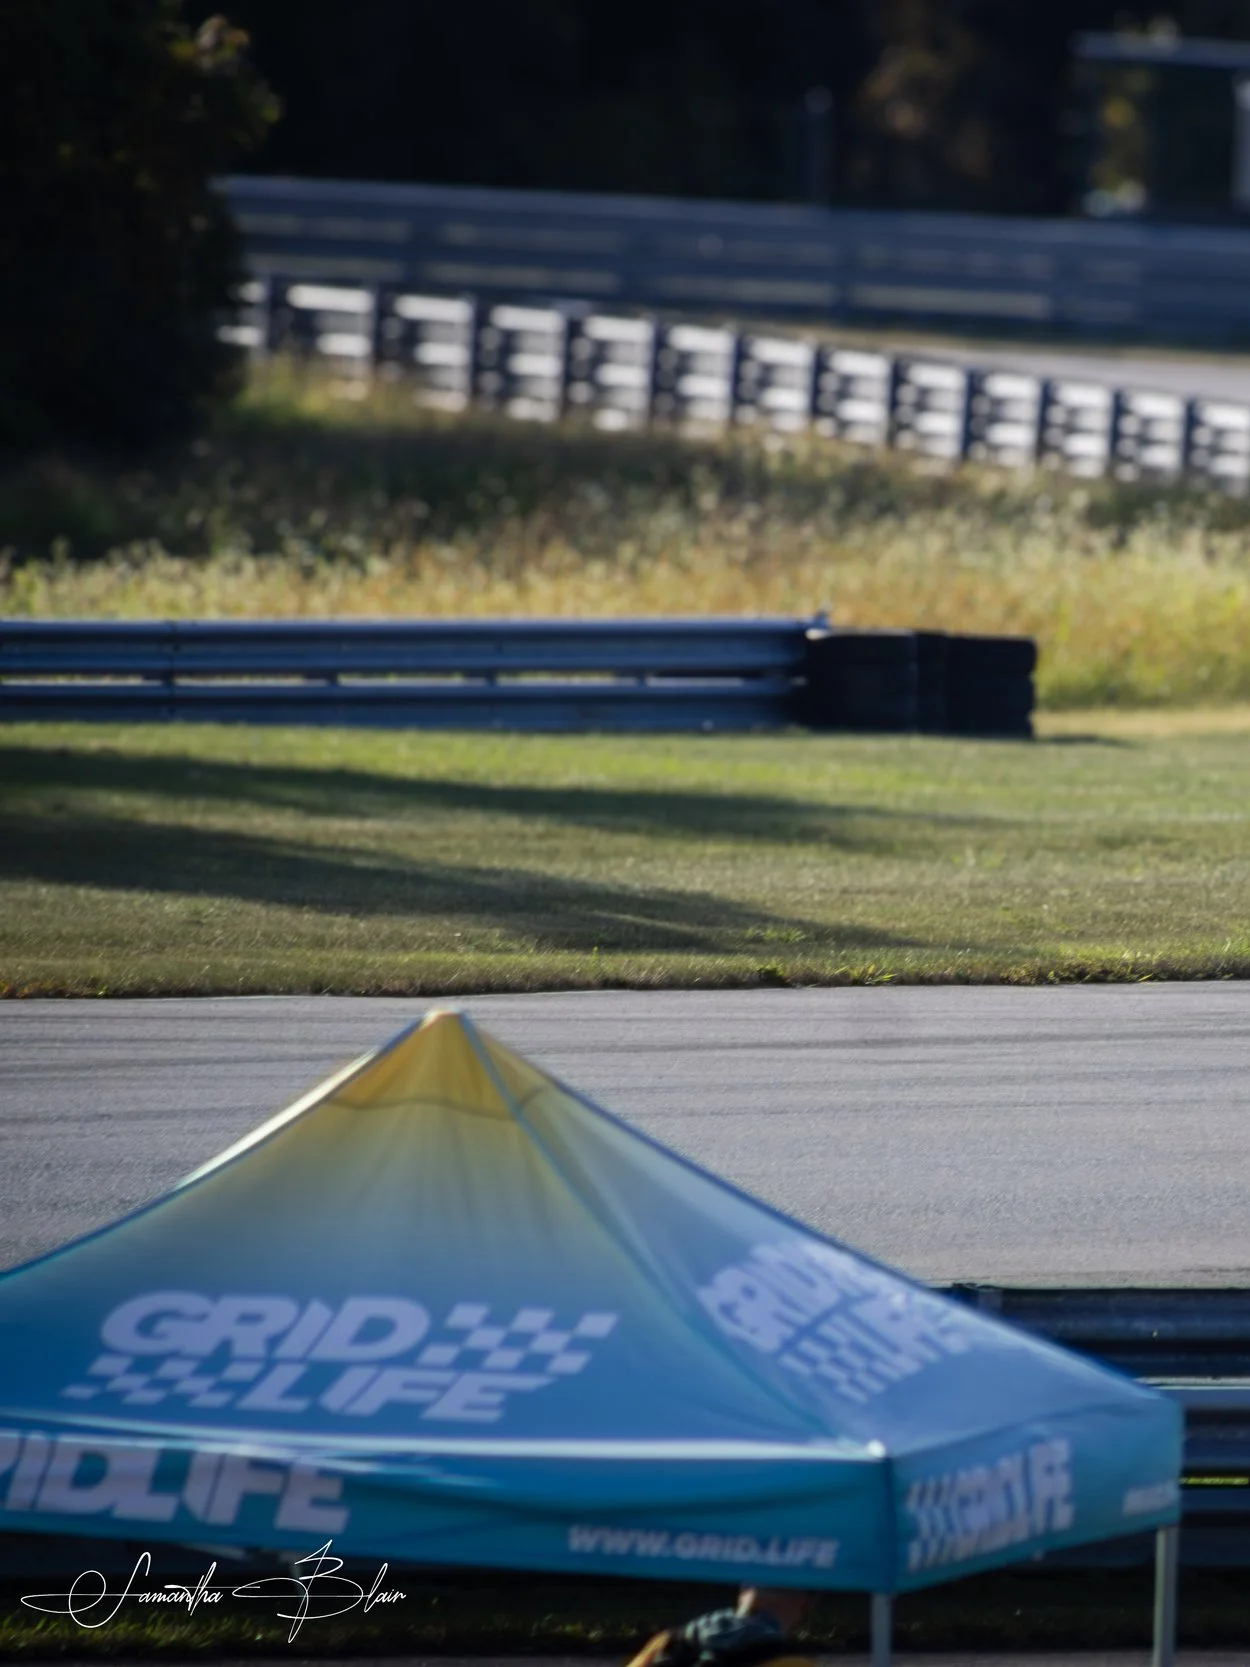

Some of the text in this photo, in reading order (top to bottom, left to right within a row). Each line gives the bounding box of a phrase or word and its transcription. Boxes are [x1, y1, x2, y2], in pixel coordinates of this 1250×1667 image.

[101, 1290, 431, 1361] GRID
[234, 1362, 557, 1422] LIFE
[568, 1524, 840, 1569] WWW.GRID.LIFE
